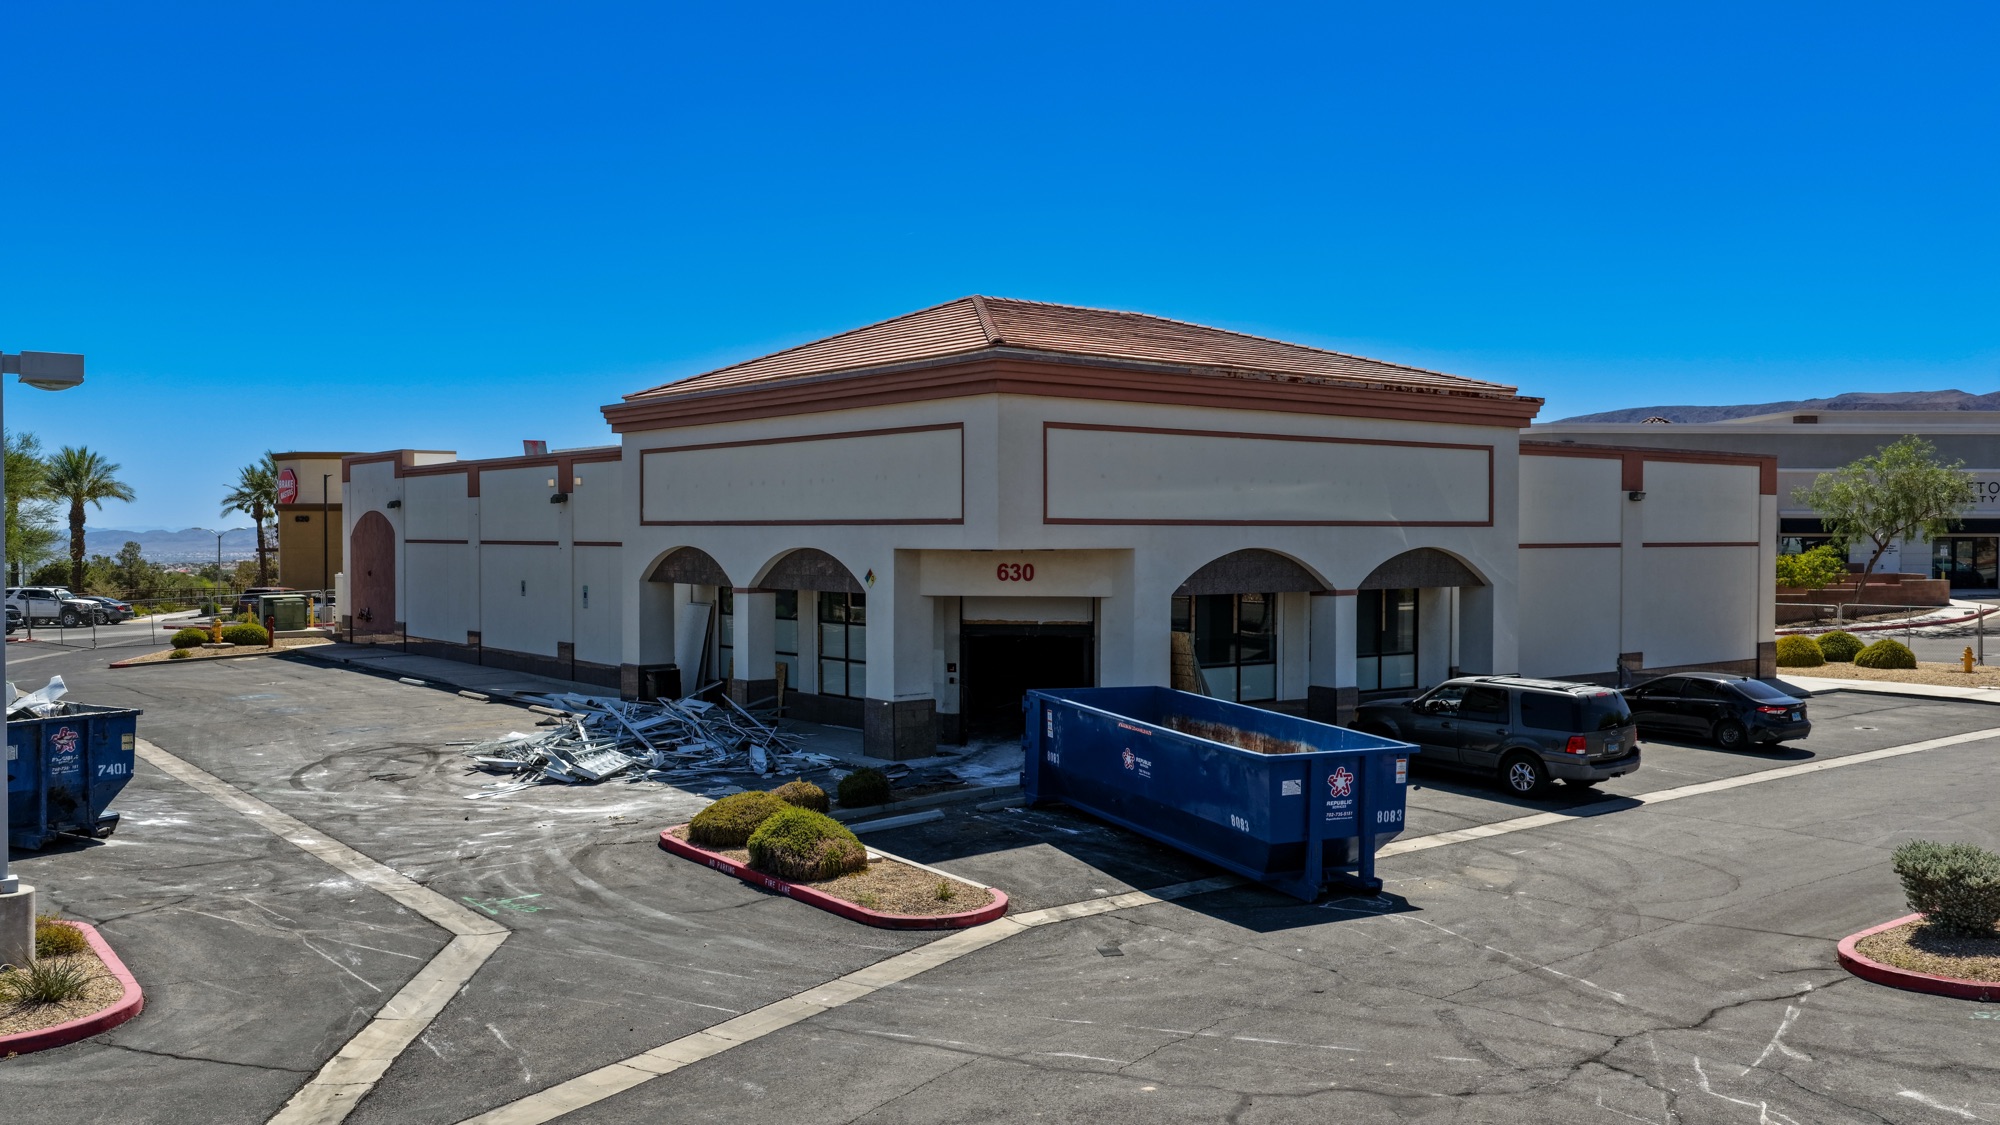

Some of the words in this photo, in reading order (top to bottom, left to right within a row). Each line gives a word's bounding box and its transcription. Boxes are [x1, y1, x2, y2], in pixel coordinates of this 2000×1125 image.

[279, 480, 293, 488] BRAKE
[996, 563, 1035, 582] 630
[98, 763, 127, 777] 7401
[1231, 814, 1249, 832] 8083
[1377, 809, 1402, 823] 8083
[717, 861, 735, 874] PARKING
[764, 878, 776, 888] FIRE
[778, 883, 791, 895] LANE
